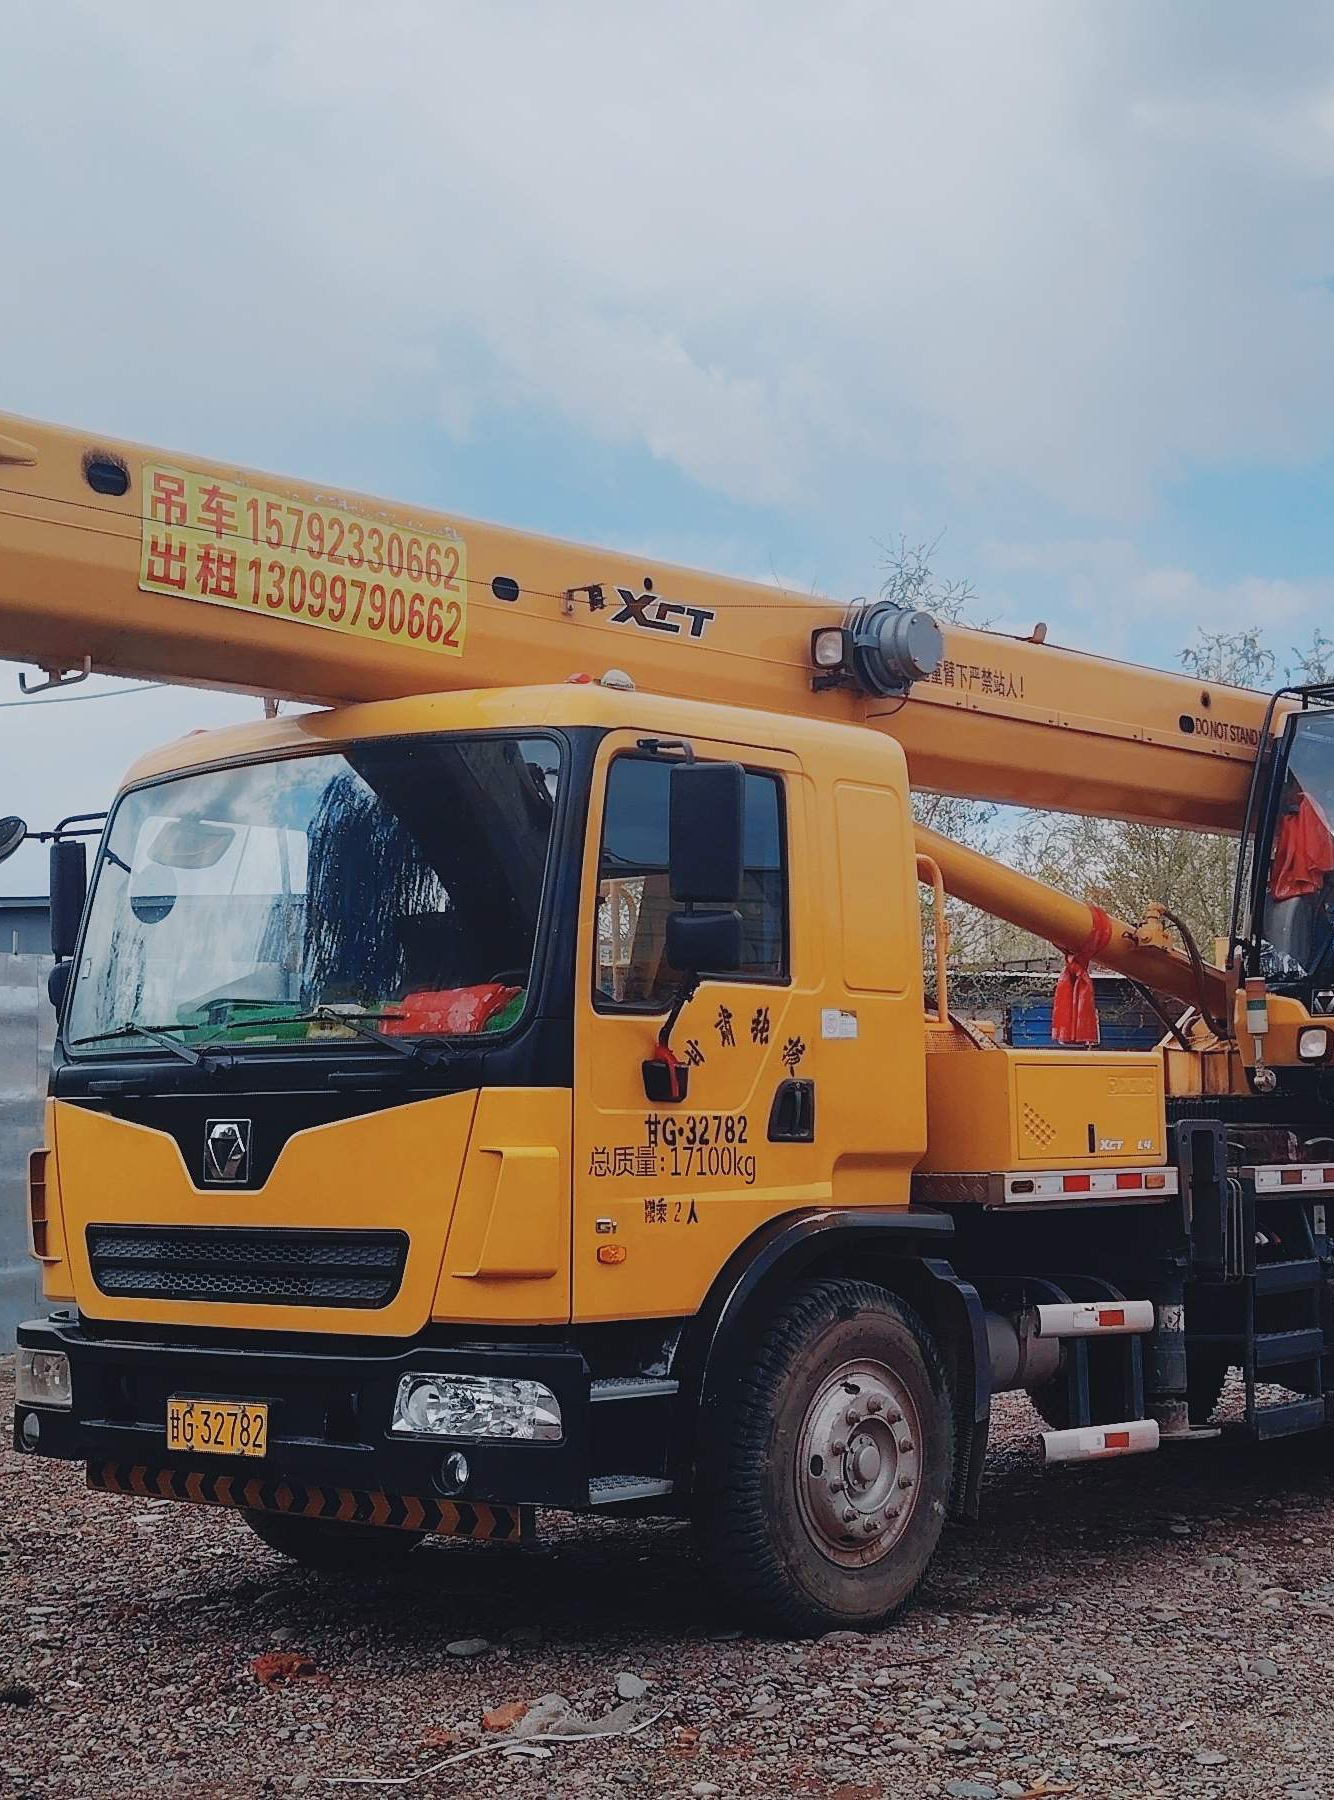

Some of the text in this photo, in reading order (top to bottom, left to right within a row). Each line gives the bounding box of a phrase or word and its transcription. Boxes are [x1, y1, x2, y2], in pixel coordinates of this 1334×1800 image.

[151, 472, 462, 593] 吊车 15792330662
[146, 532, 464, 648] 出租 13099790662
[610, 588, 715, 638] XCT
[1195, 717, 1209, 736] DO
[1210, 719, 1229, 740] NOT
[1230, 724, 1259, 745] STAND
